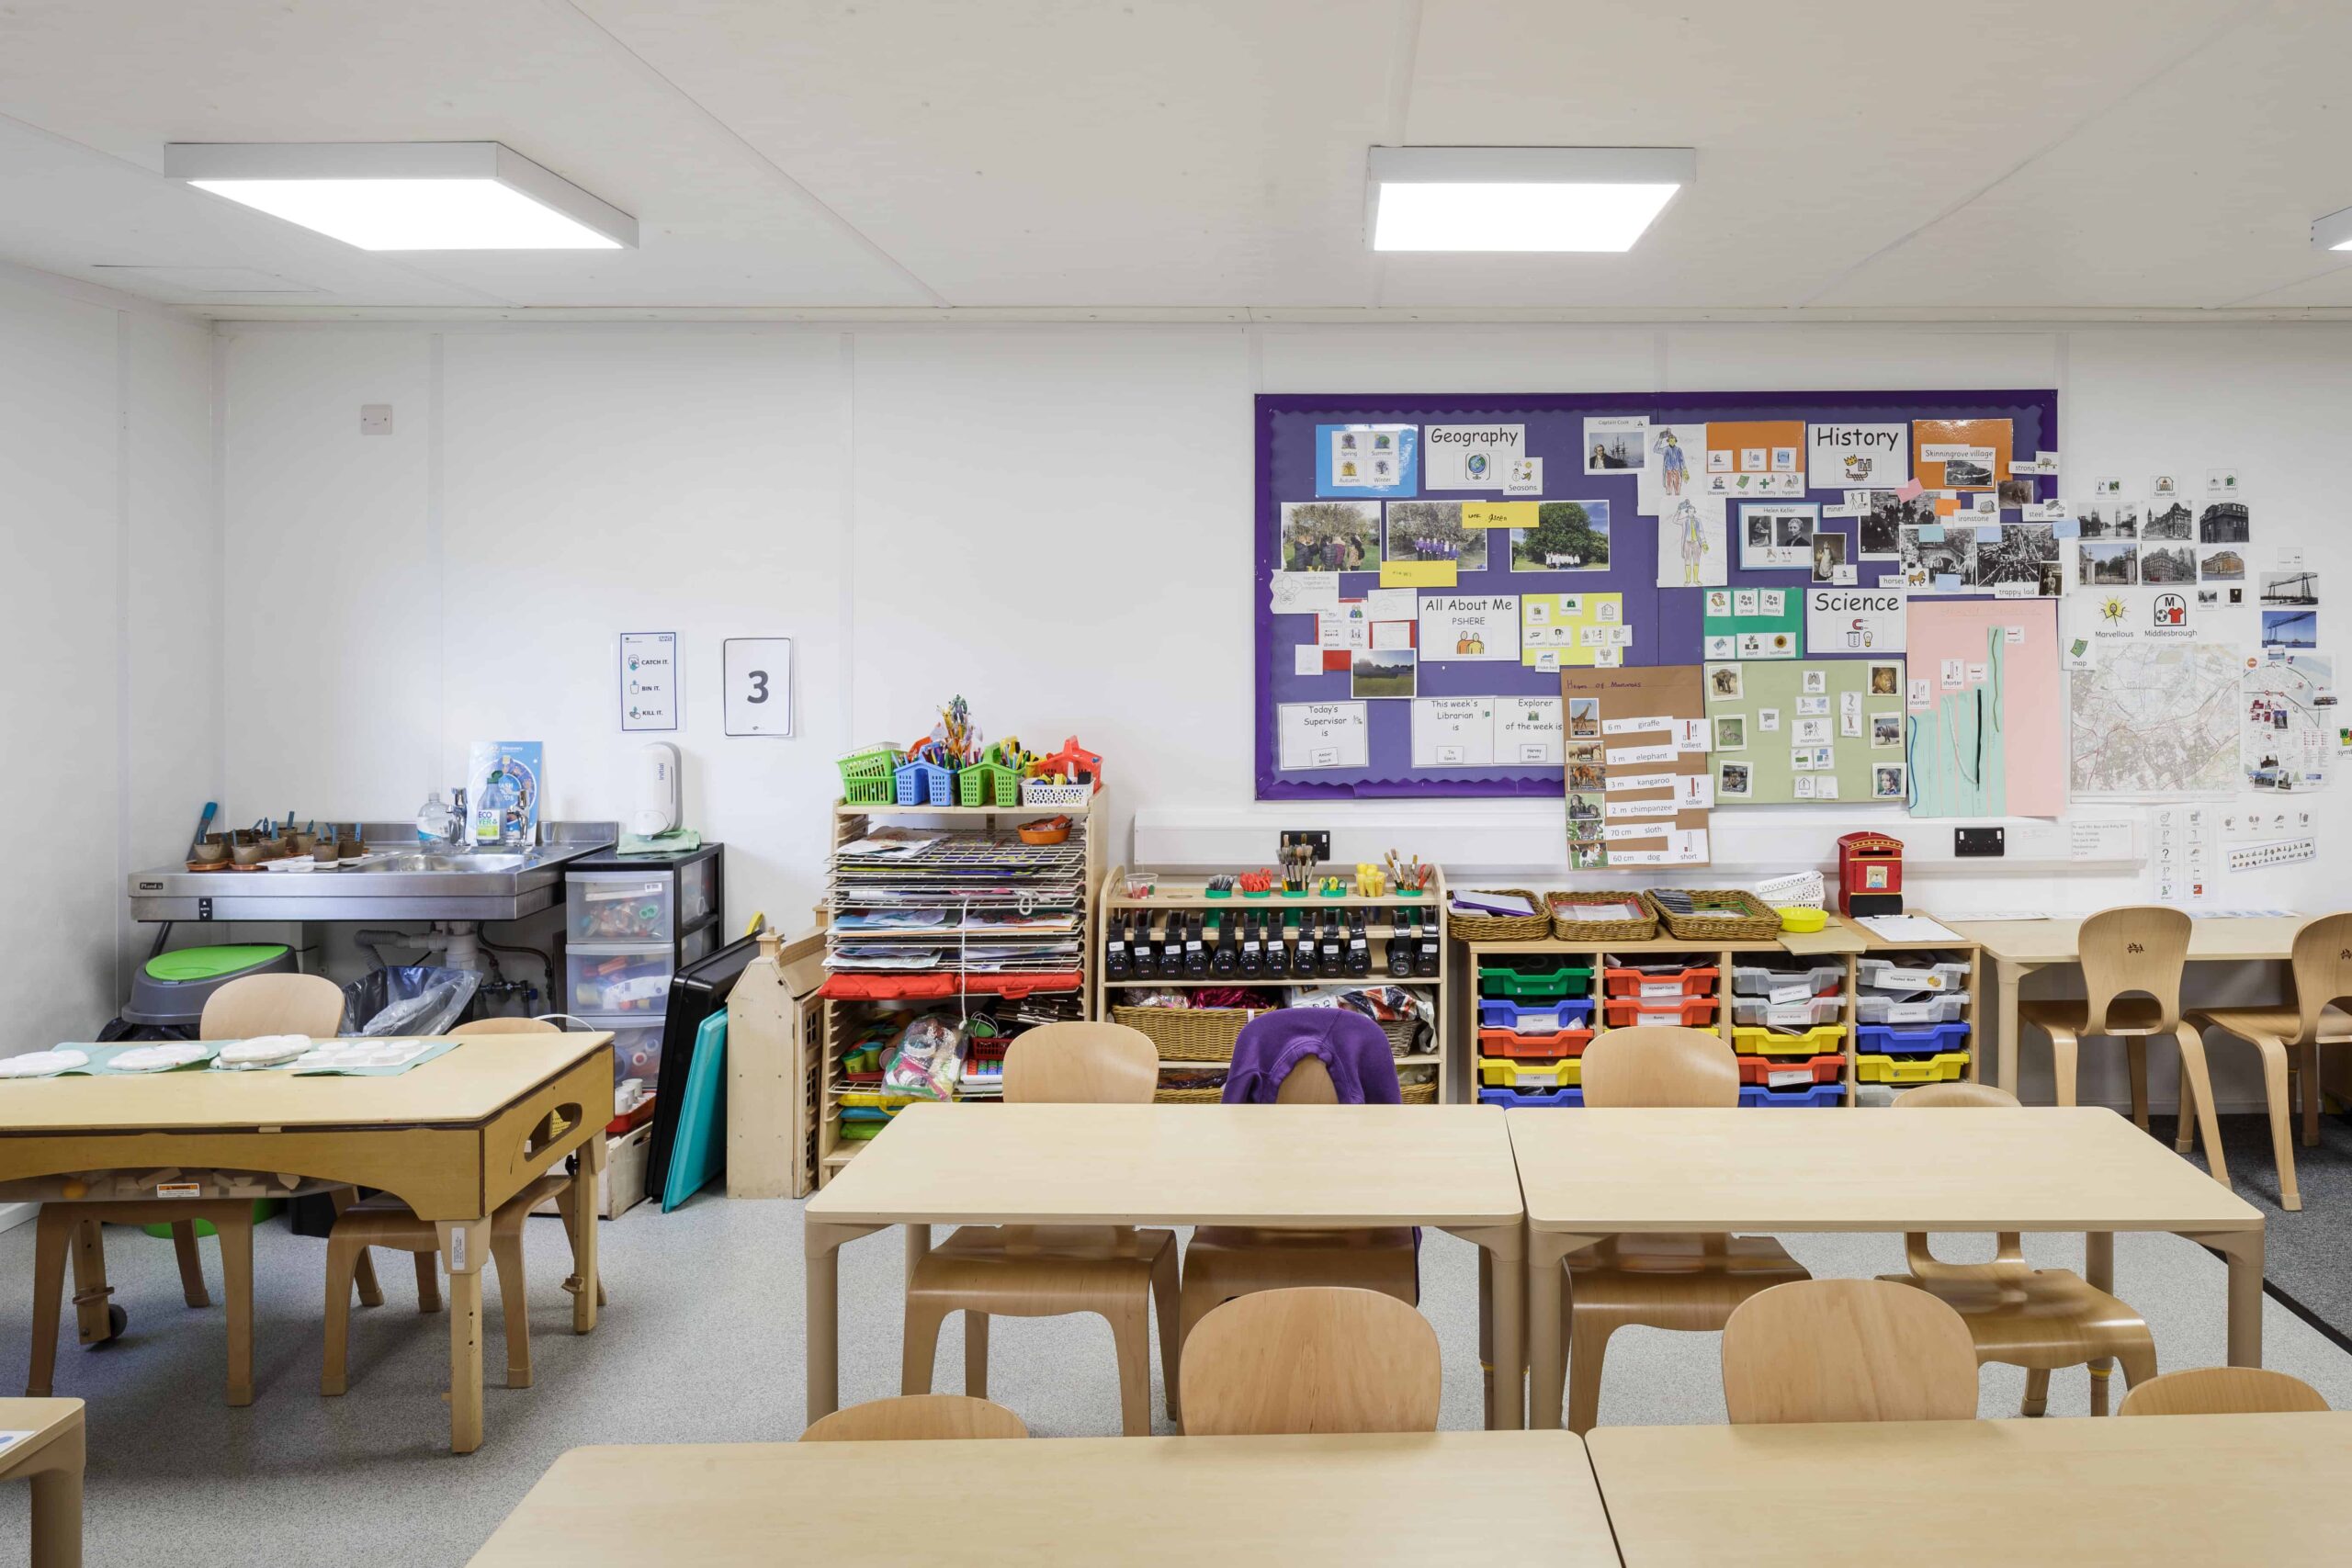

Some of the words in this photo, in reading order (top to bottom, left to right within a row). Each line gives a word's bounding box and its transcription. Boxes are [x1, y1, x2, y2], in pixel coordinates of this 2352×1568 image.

[1430, 427, 1519, 447] Geography
[1817, 427, 1899, 451] History
[1925, 449, 1969, 458] Skinningrove
[1970, 449, 1994, 458] village
[2015, 464, 2035, 472] strong
[1998, 588, 2021, 596] trappy
[1425, 599, 1442, 611] All
[1448, 599, 1488, 611] About
[1492, 598, 1513, 611] Me
[1815, 592, 1900, 612] Science
[2165, 596, 2175, 607] M
[1452, 617, 1486, 626] PSHERE
[2144, 629, 2198, 637] Middlesbrough
[746, 670, 769, 704] 3
[1430, 700, 1449, 708] This
[1450, 698, 1478, 708] week's
[1518, 698, 1554, 708] Explorer
[1307, 705, 1339, 716] Today's
[1437, 711, 1474, 720] Librarian
[1304, 716, 1348, 727] Supervisor
[1505, 722, 1514, 731] of
[1515, 722, 1531, 731] the
[1532, 722, 1554, 731] week
[1555, 722, 1563, 730] is
[1637, 719, 1660, 730] giraffe
[1453, 723, 1459, 731] is
[1321, 728, 1329, 737] is
[1635, 752, 1668, 761] elephant
[1637, 776, 1670, 787] kangaroo
[1630, 804, 1672, 814] chimpanzee
[1644, 826, 1662, 834] sloth
[1646, 853, 1661, 863] dog
